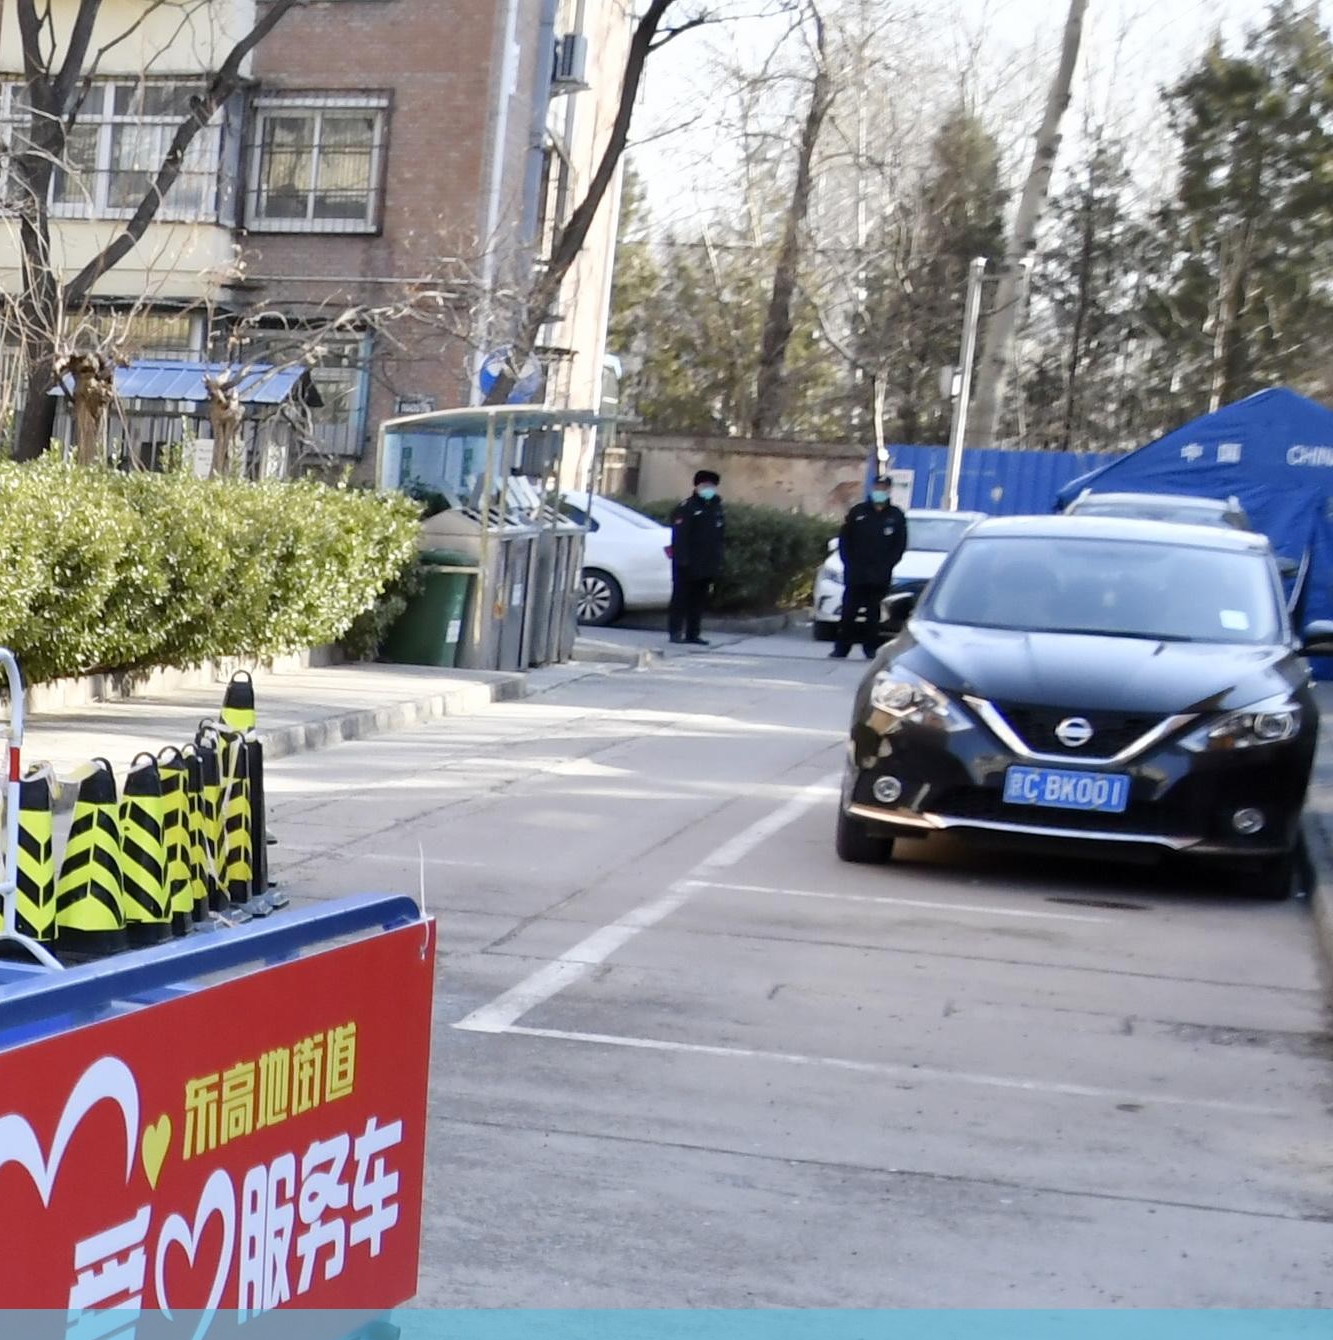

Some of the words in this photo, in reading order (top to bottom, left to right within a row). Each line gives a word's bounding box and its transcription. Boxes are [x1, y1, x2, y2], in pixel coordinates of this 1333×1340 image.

[1285, 444, 1333, 467] CHIN
[182, 1021, 358, 1160] 东高地街道
